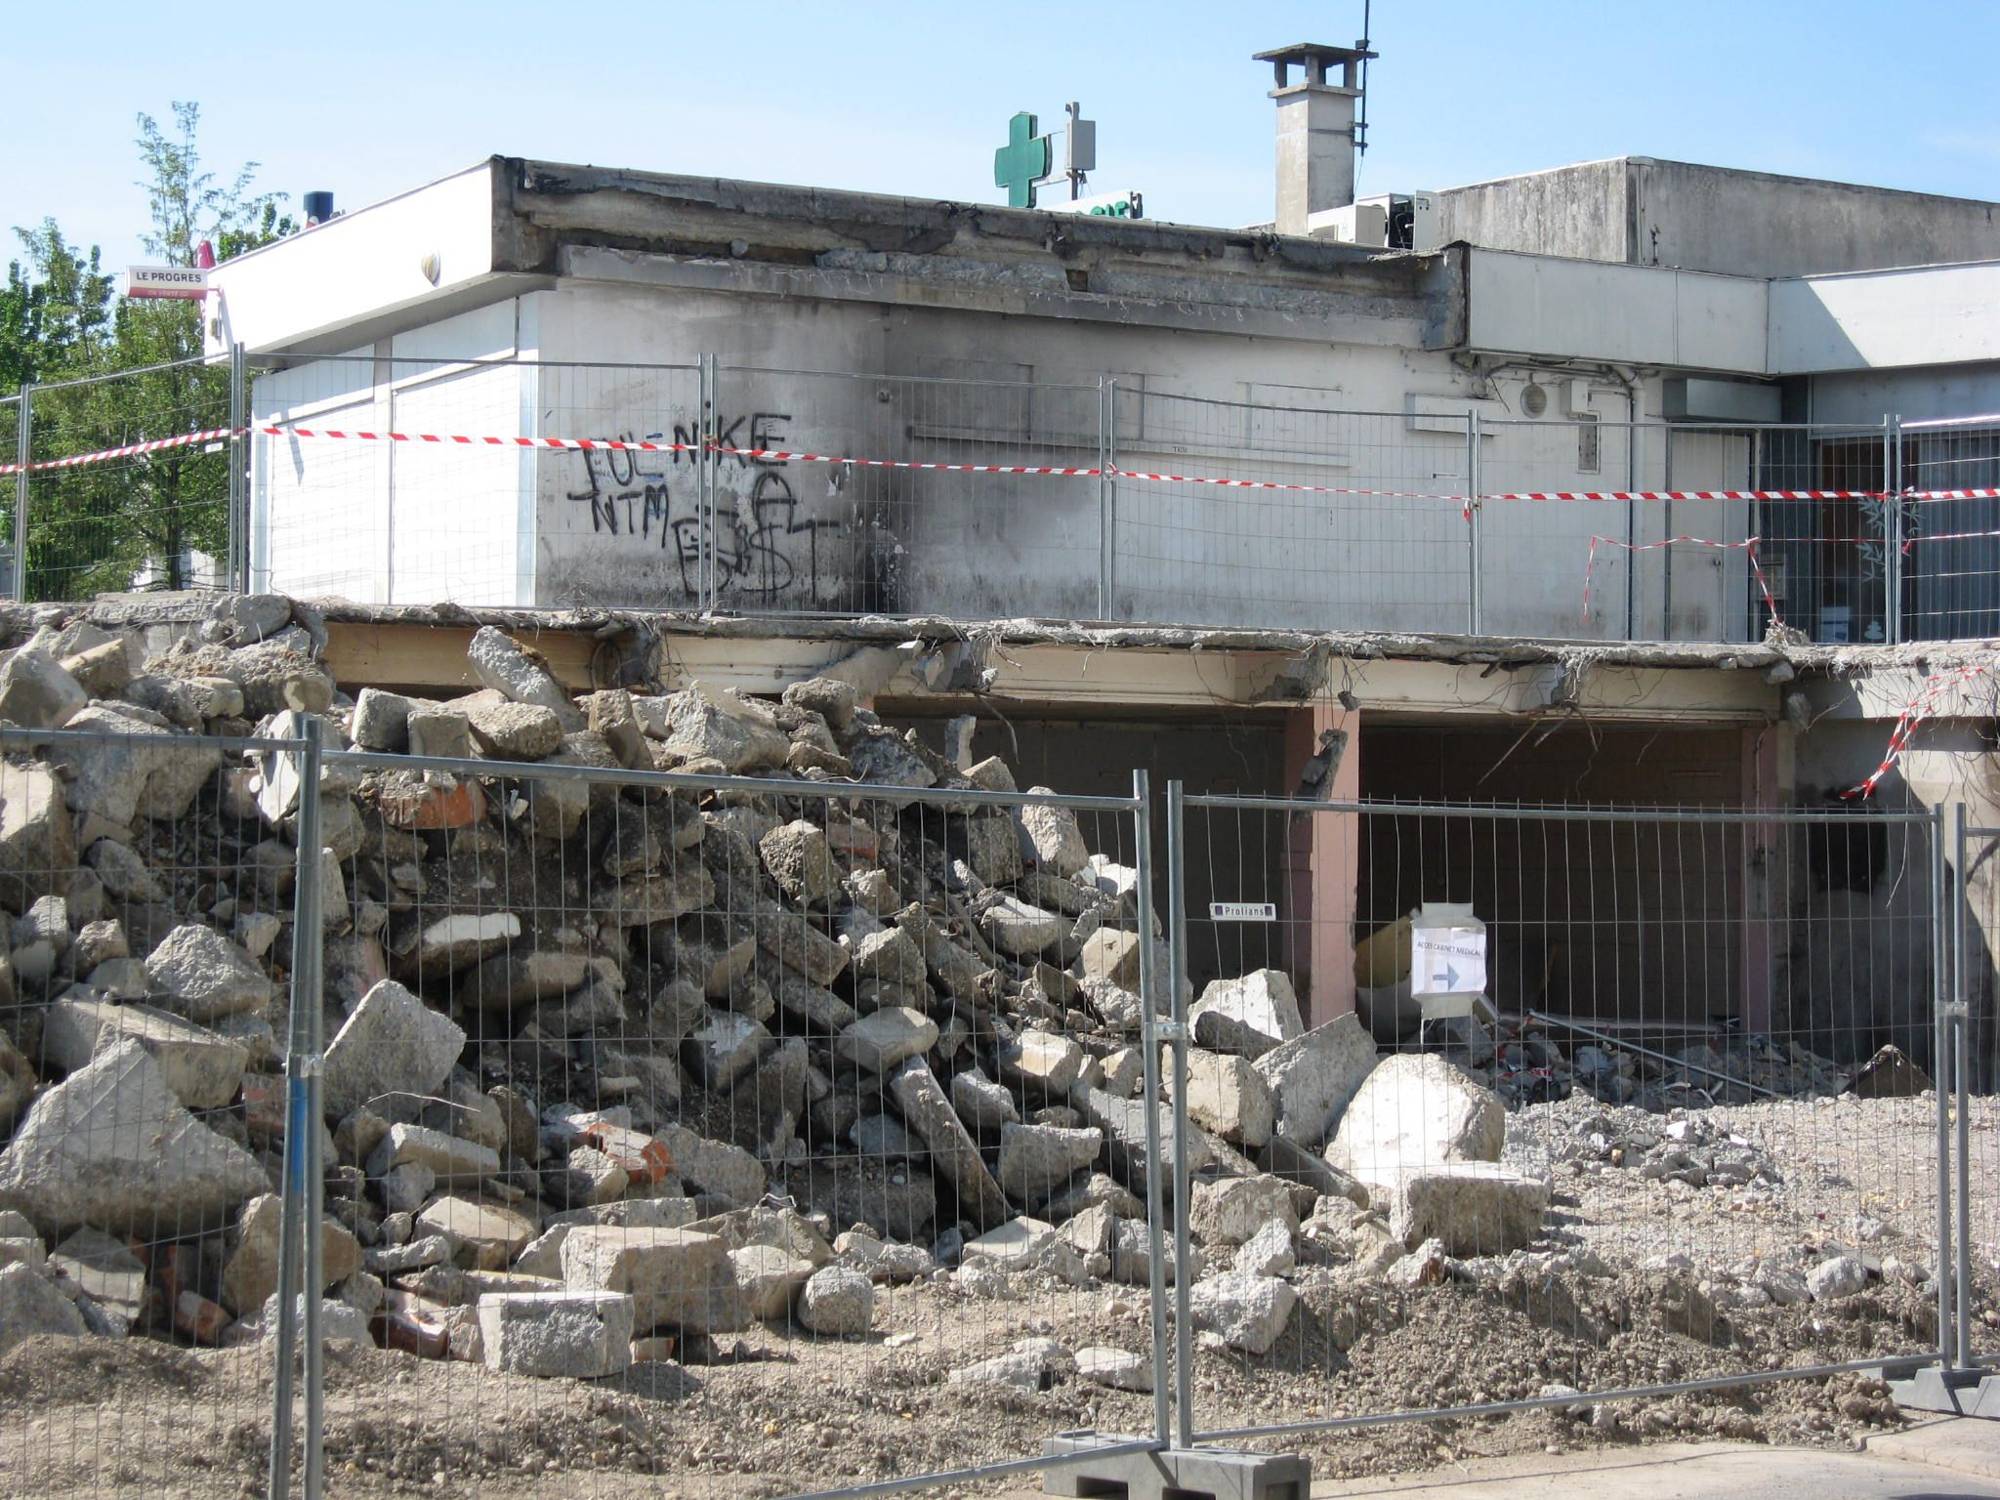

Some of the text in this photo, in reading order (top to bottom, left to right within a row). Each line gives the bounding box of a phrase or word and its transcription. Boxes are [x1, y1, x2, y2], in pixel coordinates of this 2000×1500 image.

[136, 272, 201, 282] LE PROGRES
[1225, 907, 1264, 916] Prolians
